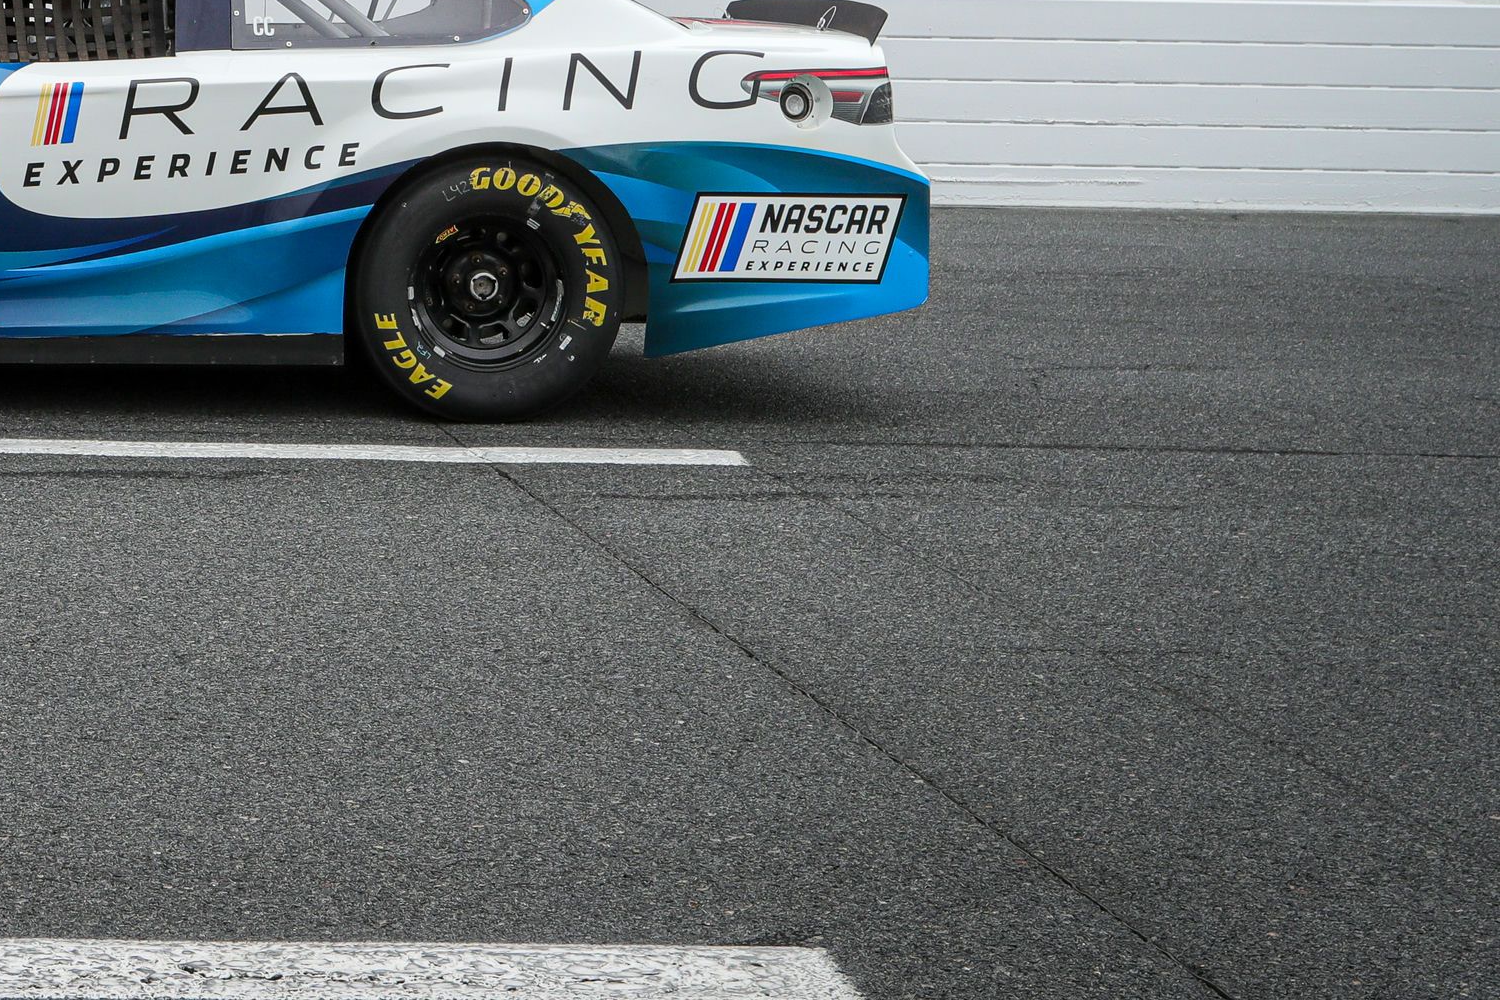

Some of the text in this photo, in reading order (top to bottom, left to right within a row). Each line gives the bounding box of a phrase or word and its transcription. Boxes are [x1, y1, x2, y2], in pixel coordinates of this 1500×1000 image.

[253, 16, 275, 36] CC
[119, 49, 765, 140] RACING
[23, 142, 360, 188] EXPERIENCE
[758, 203, 890, 235] NASCAR
[750, 239, 882, 255] RACING
[744, 260, 876, 273] EXPERIENCE
[374, 313, 453, 400] EAGLE
